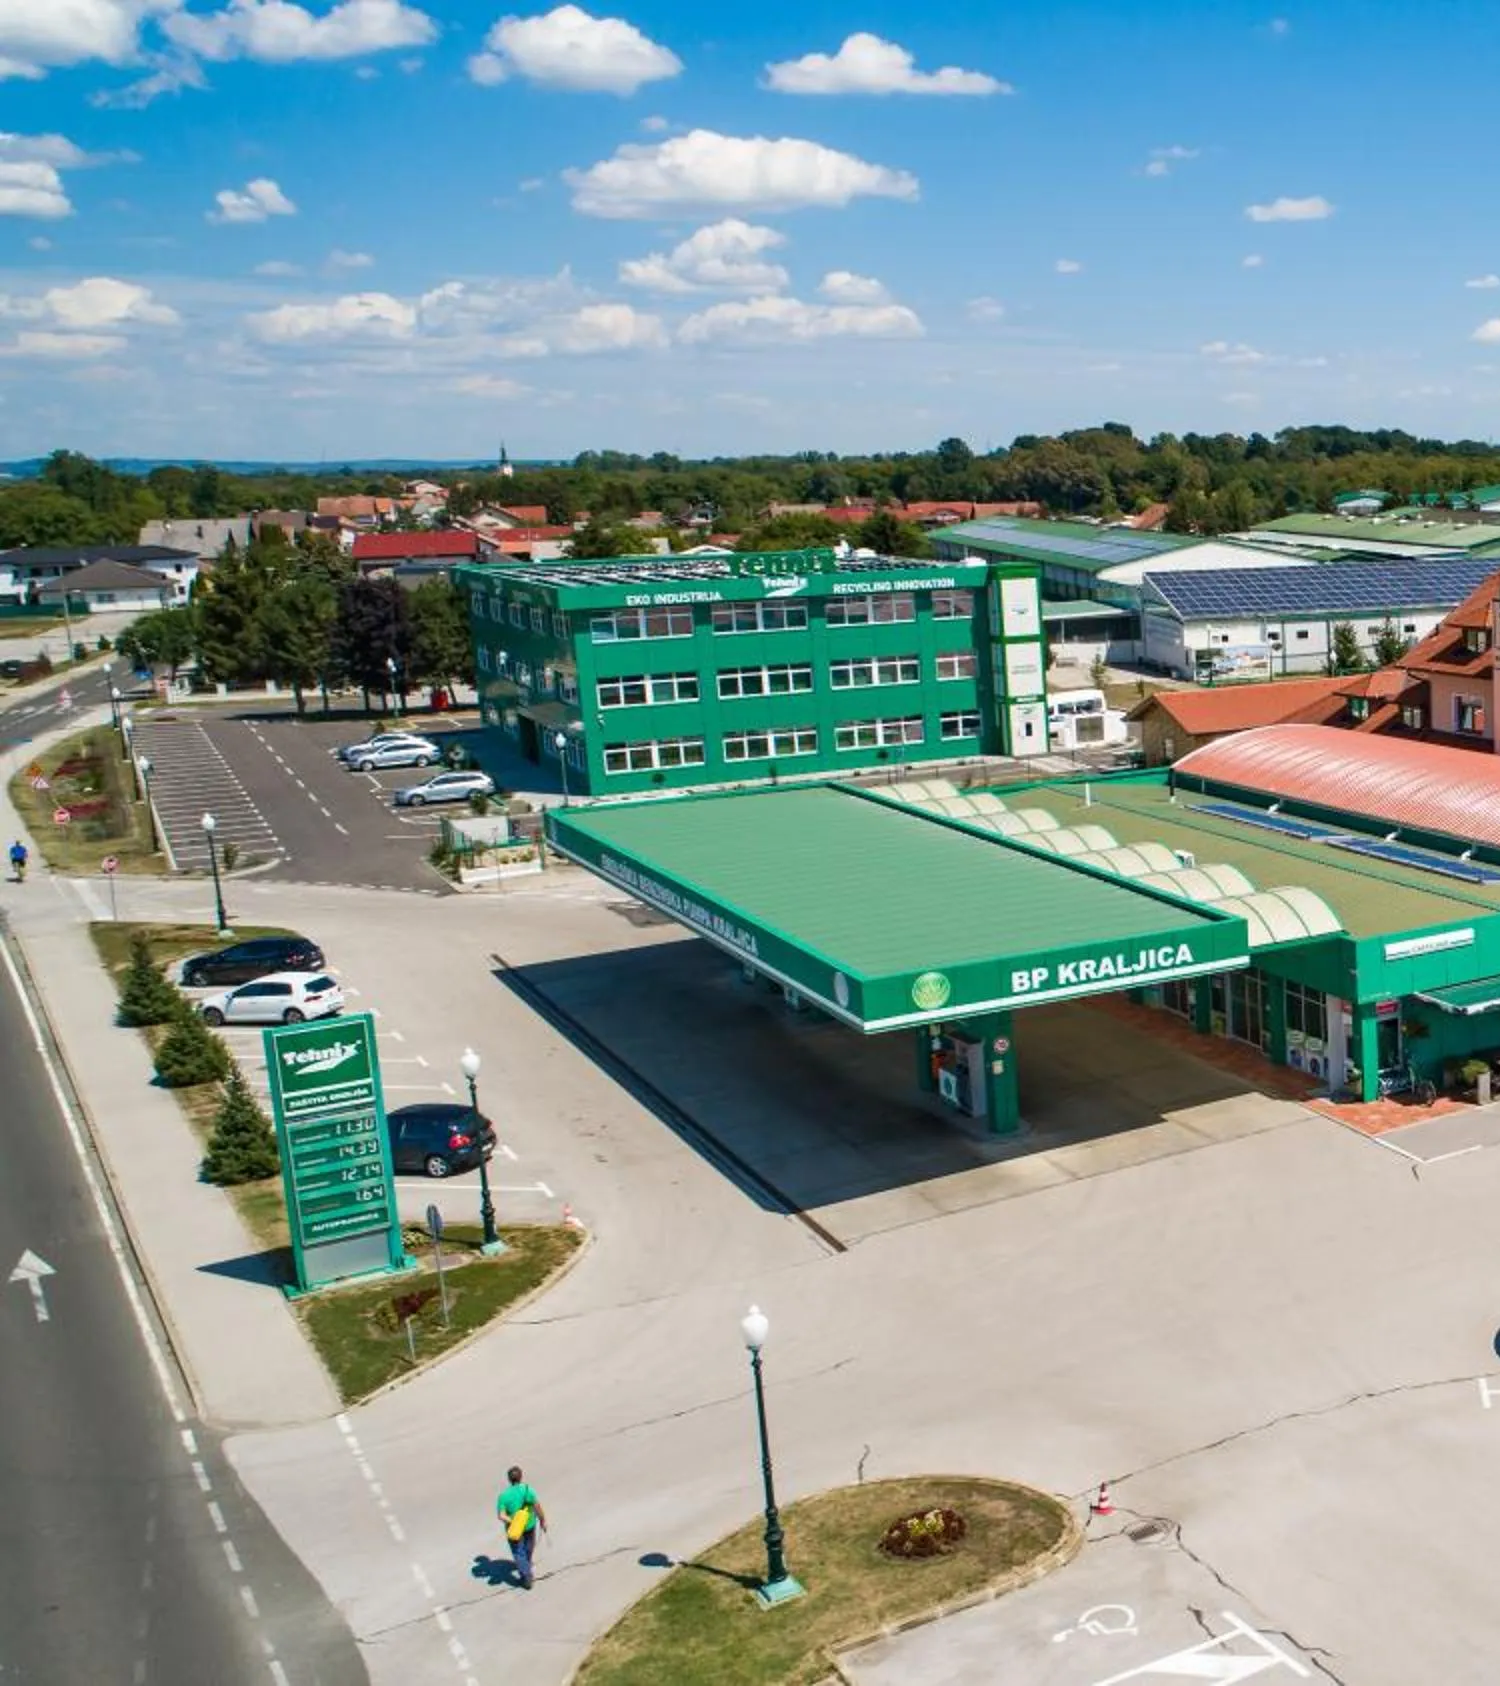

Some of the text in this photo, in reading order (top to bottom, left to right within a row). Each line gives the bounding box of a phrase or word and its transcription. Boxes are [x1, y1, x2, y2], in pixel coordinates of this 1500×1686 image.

[833, 577, 955, 594] RECYCLING INNOVATION
[626, 591, 723, 606] EKO INDUSTRIJA
[1011, 944, 1194, 993] BP KRALJICA
[282, 1041, 360, 1066] Tehnix
